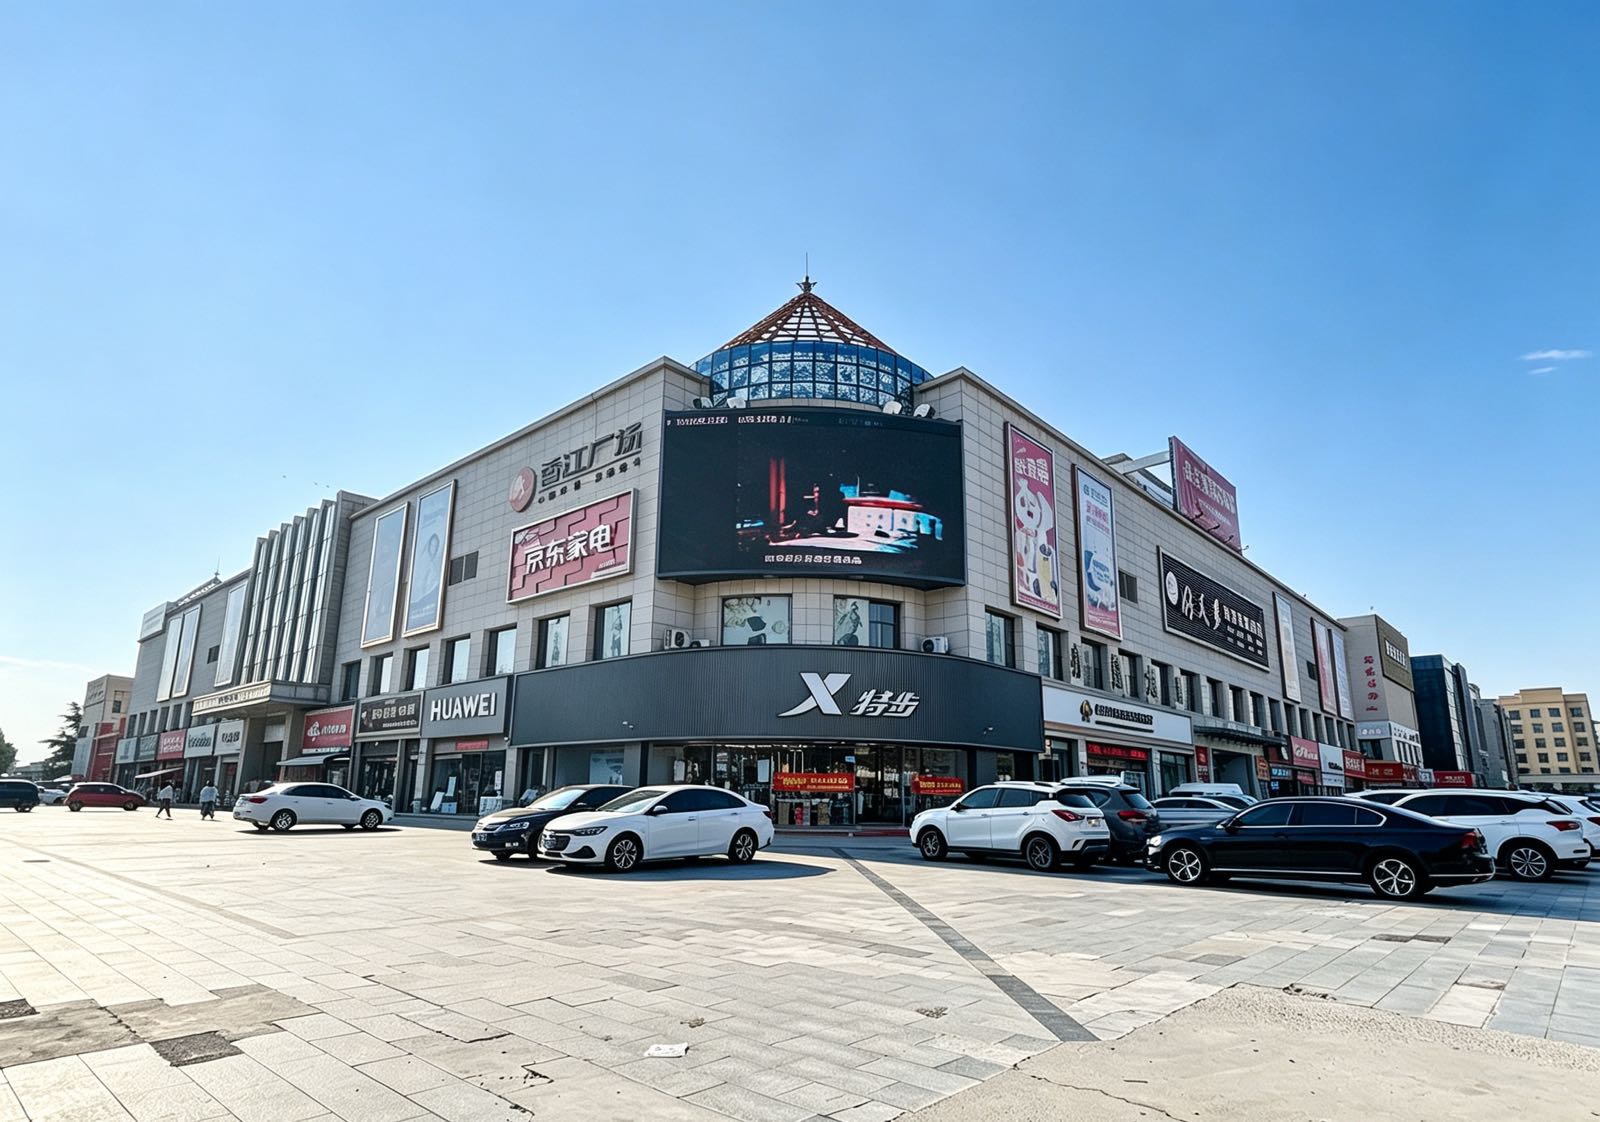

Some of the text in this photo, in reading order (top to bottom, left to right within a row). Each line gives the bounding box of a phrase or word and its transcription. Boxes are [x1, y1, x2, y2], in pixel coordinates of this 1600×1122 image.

[541, 422, 643, 487] 香江广场
[524, 524, 612, 574] 京东家电
[430, 692, 497, 721] HUAWEI
[850, 689, 920, 717] 特步
